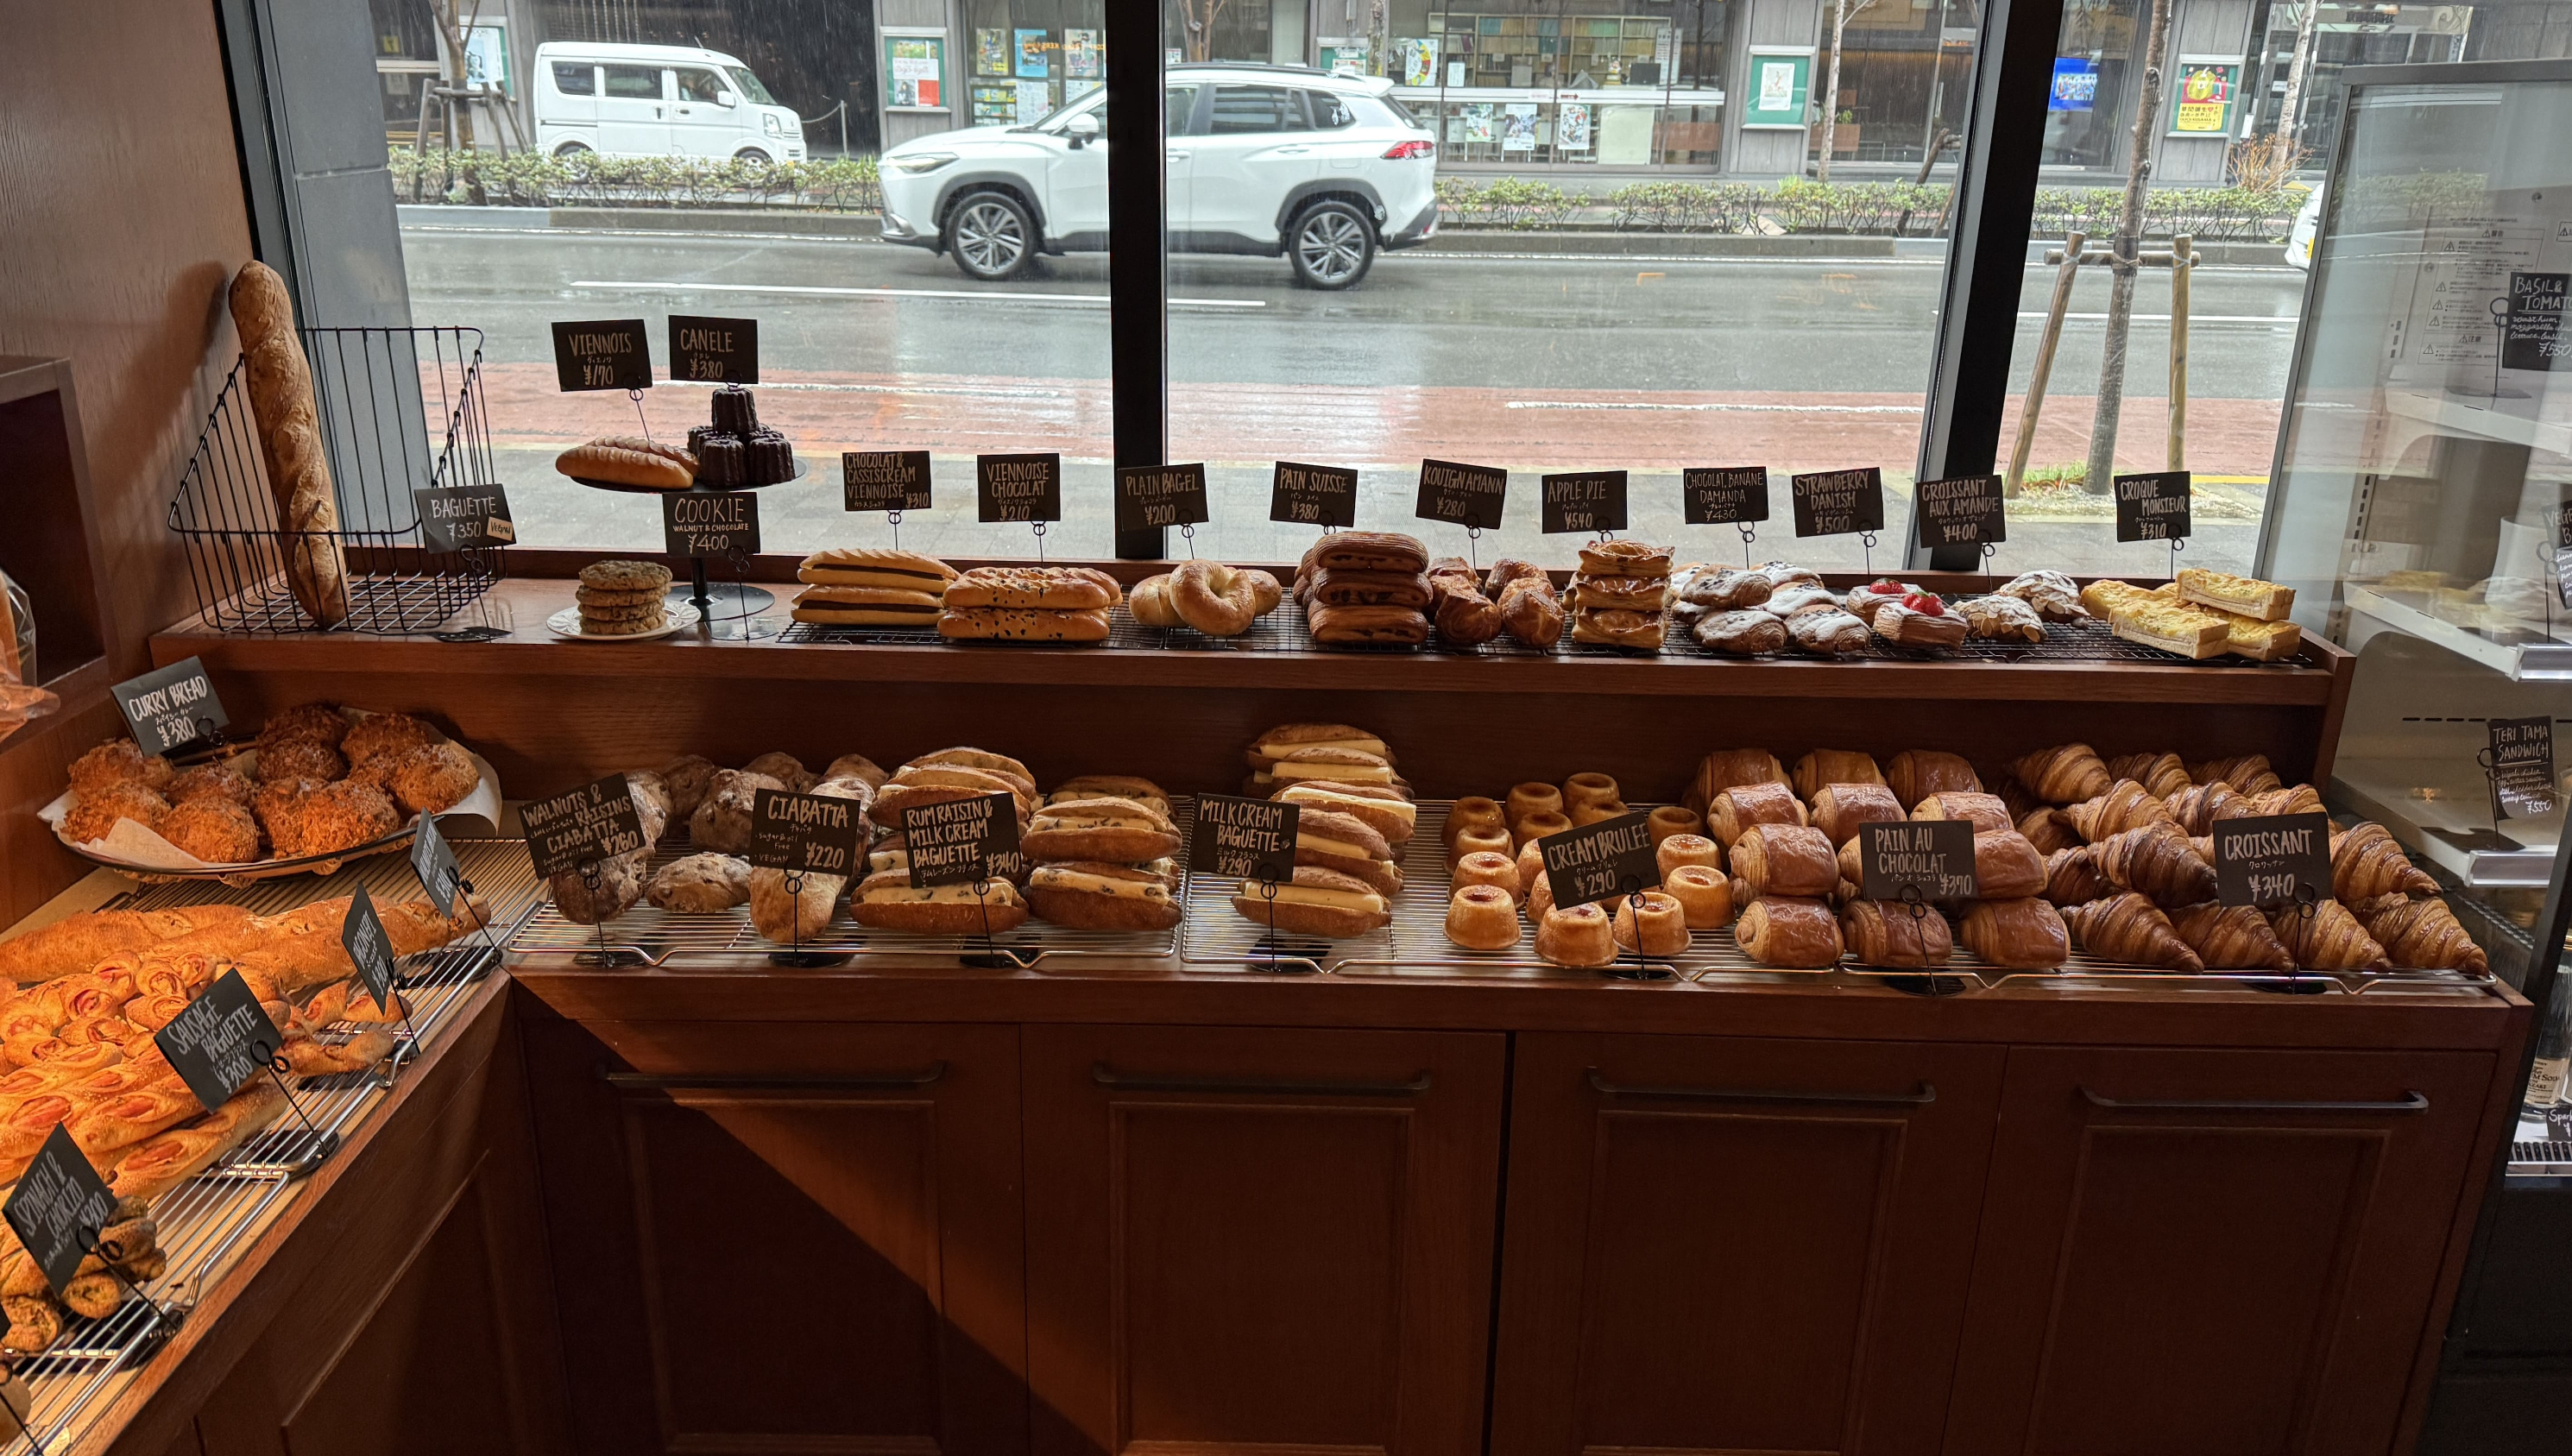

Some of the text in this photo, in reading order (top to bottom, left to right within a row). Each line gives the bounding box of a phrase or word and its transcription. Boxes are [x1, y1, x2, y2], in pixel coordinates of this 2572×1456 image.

[568, 332, 632, 356] VIENNOIS
[680, 329, 734, 352] CANELE
[583, 364, 614, 386] ¥170
[690, 359, 723, 379] ¥380
[846, 453, 904, 471] CHOCOLAT &
[986, 462, 1049, 482] VIENNOISE
[847, 483, 904, 499] VIENNOISE
[992, 480, 1046, 498] CHOCOLAT
[1125, 472, 1199, 496] PLAIN BAGEL
[1279, 468, 1347, 493] PAIN SUISSE
[1548, 480, 1607, 503] APPLE PIE
[1728, 472, 1763, 488] BANANE
[1795, 470, 1869, 496] STRAWBERRY
[1922, 479, 1987, 501] CROISSANT
[2120, 479, 2159, 501] CROQUE
[431, 496, 497, 519] BAGUETTE
[675, 498, 744, 523] COOKIE
[905, 491, 929, 508] ¥310
[1290, 501, 1320, 520] ¥380
[1436, 496, 1466, 517] ¥280
[1811, 491, 1857, 510] DANISH
[1929, 496, 1999, 518] AUX AMANDE
[2141, 495, 2186, 516] MONSIEUR
[999, 505, 1031, 521] ¥210
[1144, 504, 1176, 526] ¥200
[1565, 512, 1592, 530] ¥540
[1705, 509, 1737, 522] ¥430
[1815, 515, 1850, 534] ¥500
[446, 521, 482, 542] ¥350
[711, 522, 749, 532] CHOCOLATE
[1943, 523, 1978, 542] ¥400
[2140, 521, 2167, 539] ¥310
[688, 533, 728, 554] ¥400
[128, 676, 208, 722] CURRY BREAD
[156, 715, 196, 747] ¥380
[2493, 725, 2549, 744] TERI TAMA
[2498, 742, 2549, 761] SANDWICH
[522, 784, 602, 828] WALNUTS &
[574, 796, 632, 827] RAISINS
[767, 795, 848, 829] CIABATTA
[906, 798, 993, 829] RUM RAISIN &
[1200, 799, 1283, 829] MILK CREAM
[546, 818, 620, 854] CIABATTA
[600, 830, 639, 856] ¥260
[909, 818, 989, 848] MILK CREAM
[1216, 824, 1280, 852] BAGUETTE
[1875, 827, 1933, 853] PAIN AU
[2225, 829, 2313, 860] CROISSANT
[804, 841, 845, 869] ¥220
[913, 842, 981, 869] BAGUETTE
[1548, 823, 1650, 872] CREAM BRULEE
[986, 851, 1019, 878] ¥340
[1217, 855, 1252, 877] ¥290
[1878, 853, 1947, 874] CHOCOLAT
[1574, 869, 1617, 898] ¥290
[1939, 873, 1972, 896] ¥370
[2248, 873, 2295, 903] ¥340
[372, 955, 388, 996] ¥300
[167, 995, 223, 1055] SAUSAGE
[200, 1003, 258, 1063] BAGUETTE
[215, 1056, 254, 1094] ¥300
[14, 1162, 60, 1237] SPINACH
[46, 1150, 66, 1185] &
[45, 1175, 85, 1239] CHORIZO
[79, 1190, 109, 1231] ¥300
